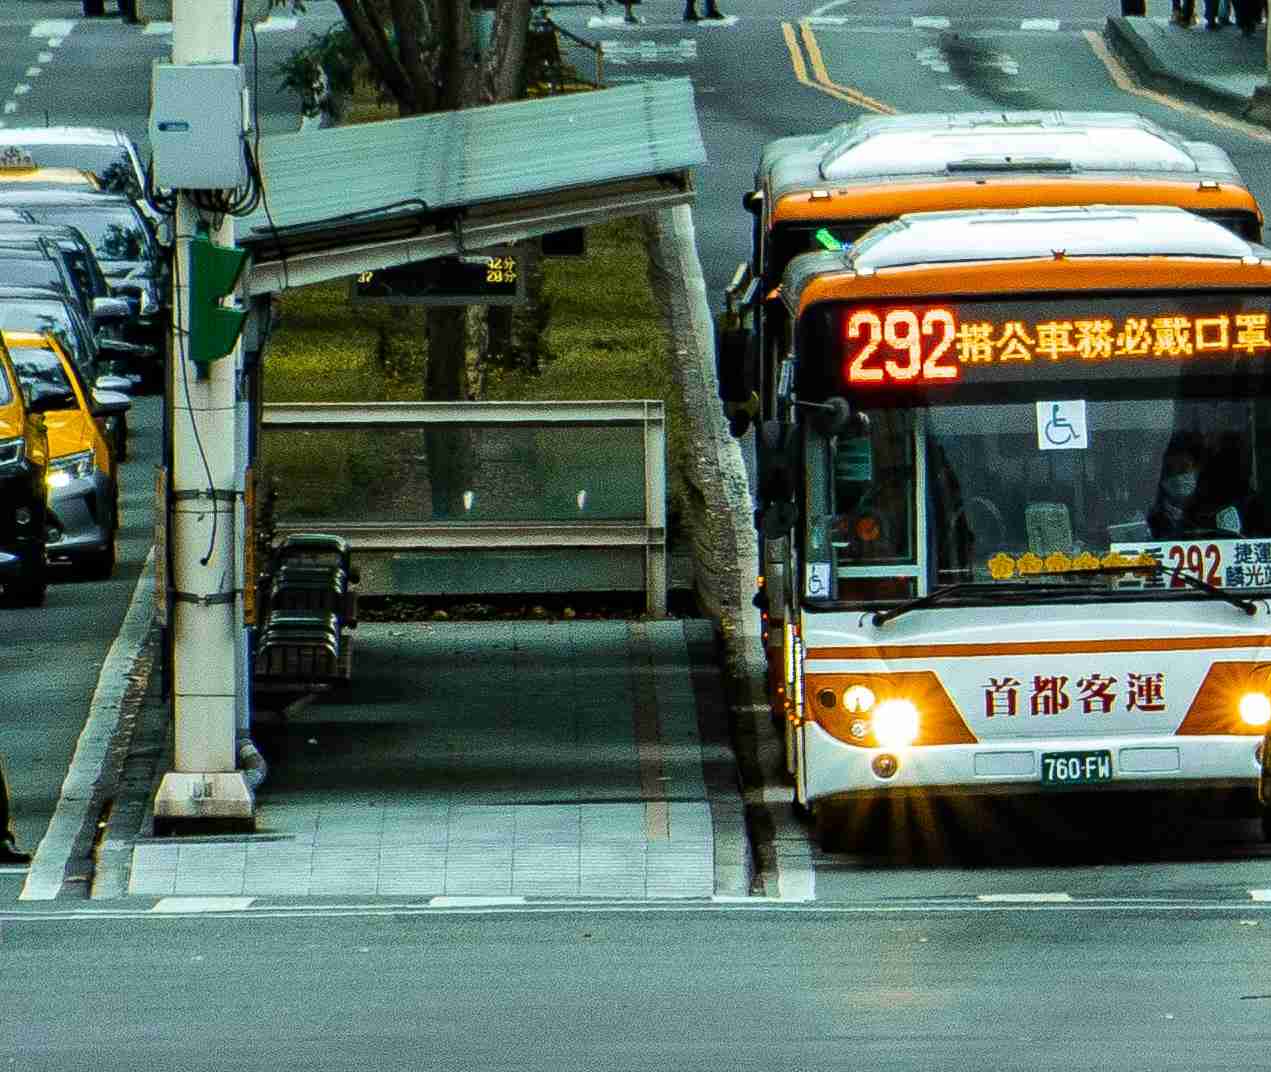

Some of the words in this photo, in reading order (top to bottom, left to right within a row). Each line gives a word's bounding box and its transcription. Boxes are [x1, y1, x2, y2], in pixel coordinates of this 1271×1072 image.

[847, 309, 959, 384] 292
[957, 313, 1271, 363] 搭公車務必戴口罩
[1169, 543, 1222, 588] 292
[981, 672, 1167, 718] 首都客運
